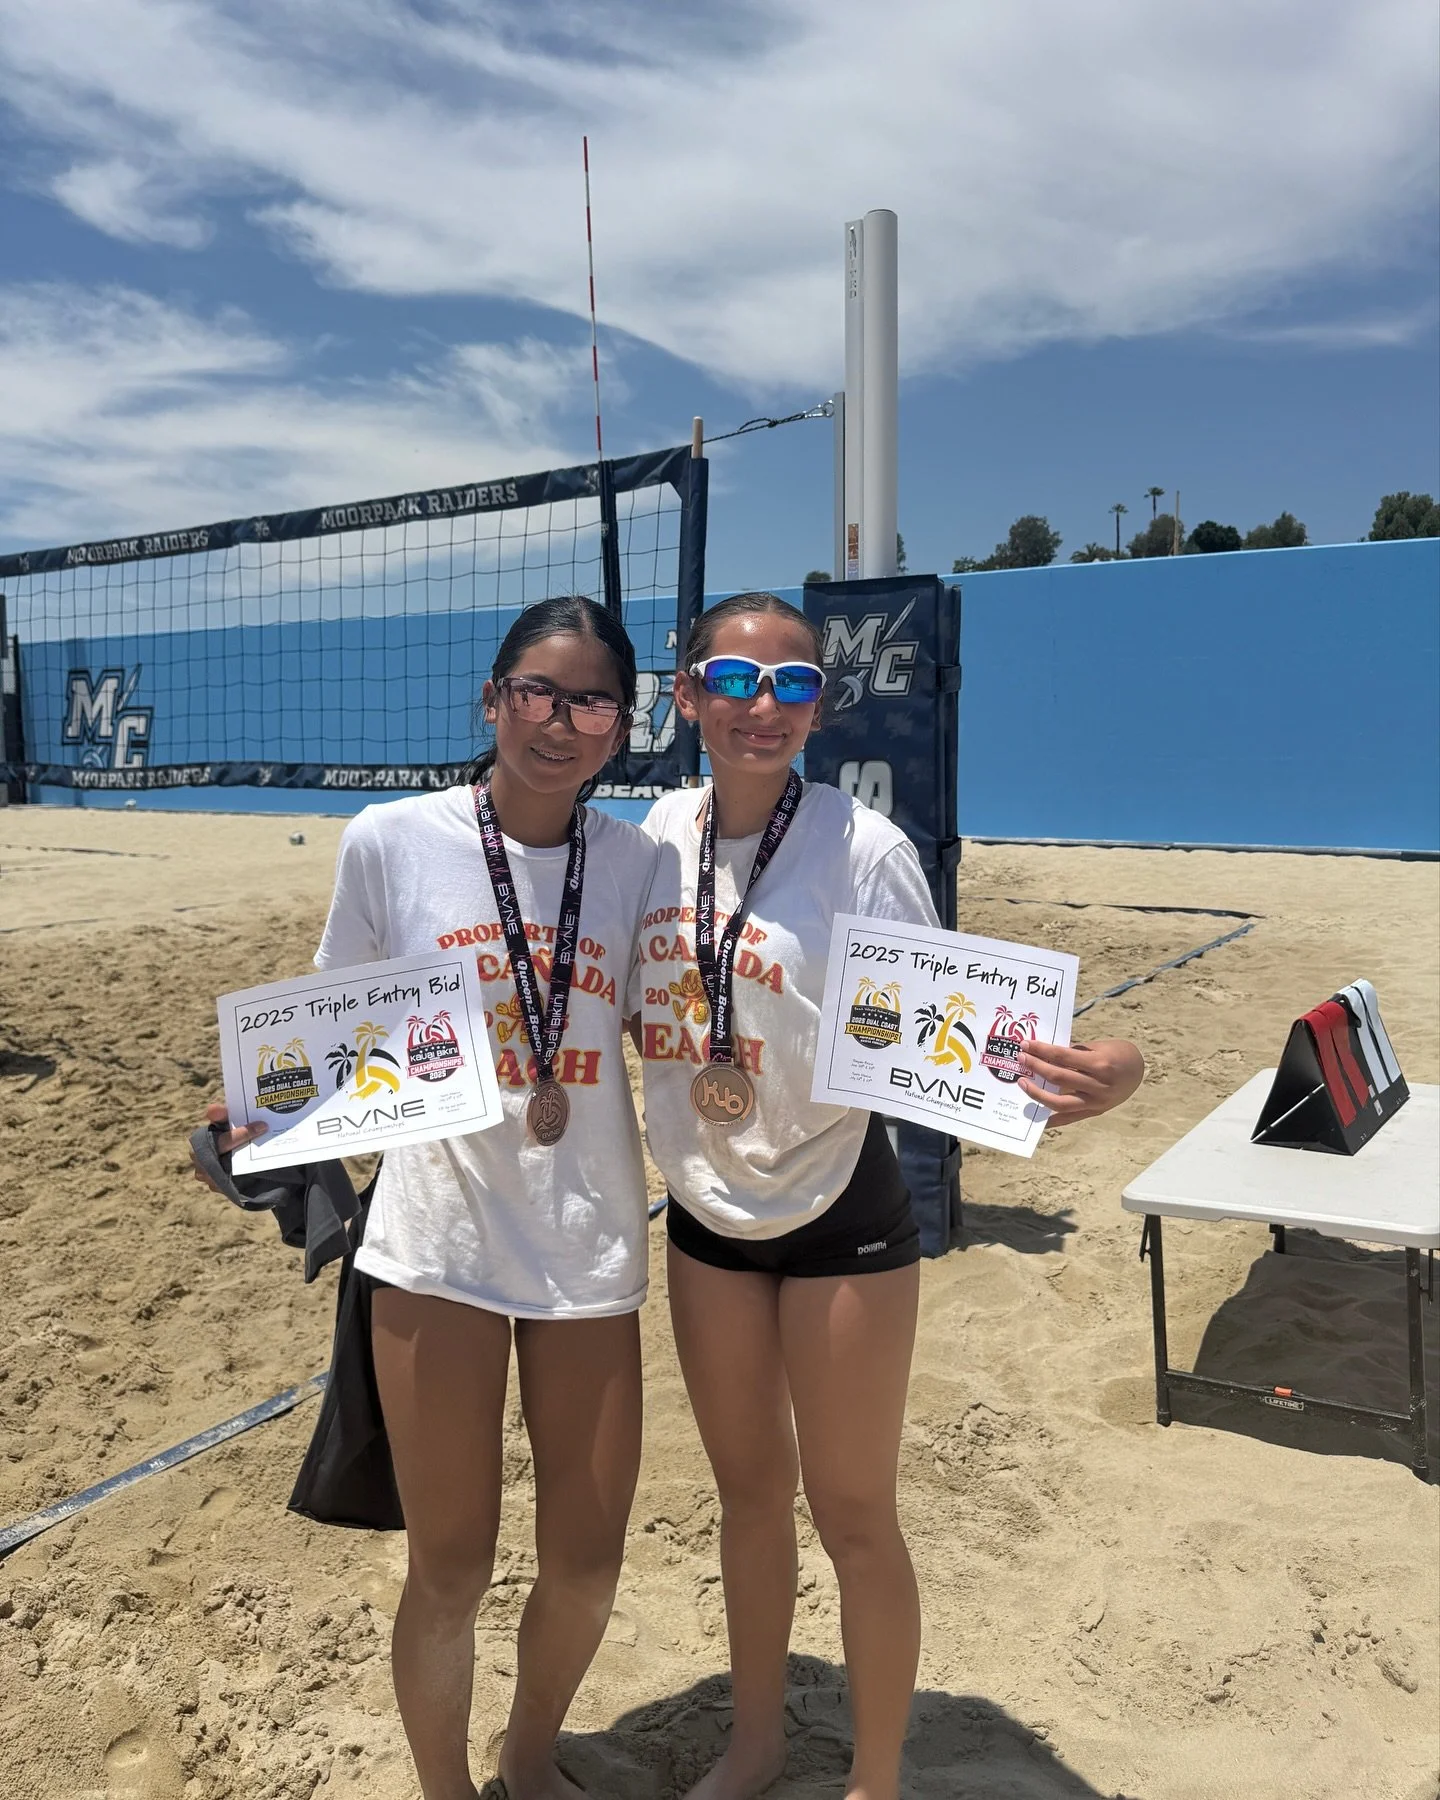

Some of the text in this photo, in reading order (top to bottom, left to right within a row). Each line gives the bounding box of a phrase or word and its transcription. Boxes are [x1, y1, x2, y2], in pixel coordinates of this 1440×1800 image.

[320, 482, 519, 530] MOORPARK RAIDERS
[145, 530, 209, 554] RAIDERS
[323, 769, 424, 788] MOORPARK
[498, 883, 519, 936] BVNE
[701, 894, 710, 945] BVNE
[560, 913, 576, 965] BVNE
[740, 922, 768, 946] OF
[578, 937, 606, 961] OF
[850, 942, 1058, 999] 2025 Triple Entry Bid
[240, 974, 461, 1033] 2025 Triple Entry Bid
[716, 996, 727, 1040] Beach
[866, 1018, 879, 1027] DUAL
[880, 1021, 898, 1031] COAST
[848, 1025, 899, 1041] CHAMPIONSHIPS
[410, 1058, 462, 1075] CHAMPIONSHIPS
[429, 1070, 447, 1080] 2025
[998, 1070, 1015, 1081] 2025
[260, 1079, 311, 1094] 2025 DUAL COAST
[260, 1087, 316, 1105] CHAMPIONSHIPS
[889, 1067, 986, 1110] BVNE
[904, 1089, 962, 1113] National Championships
[317, 1099, 426, 1136] BVNE
